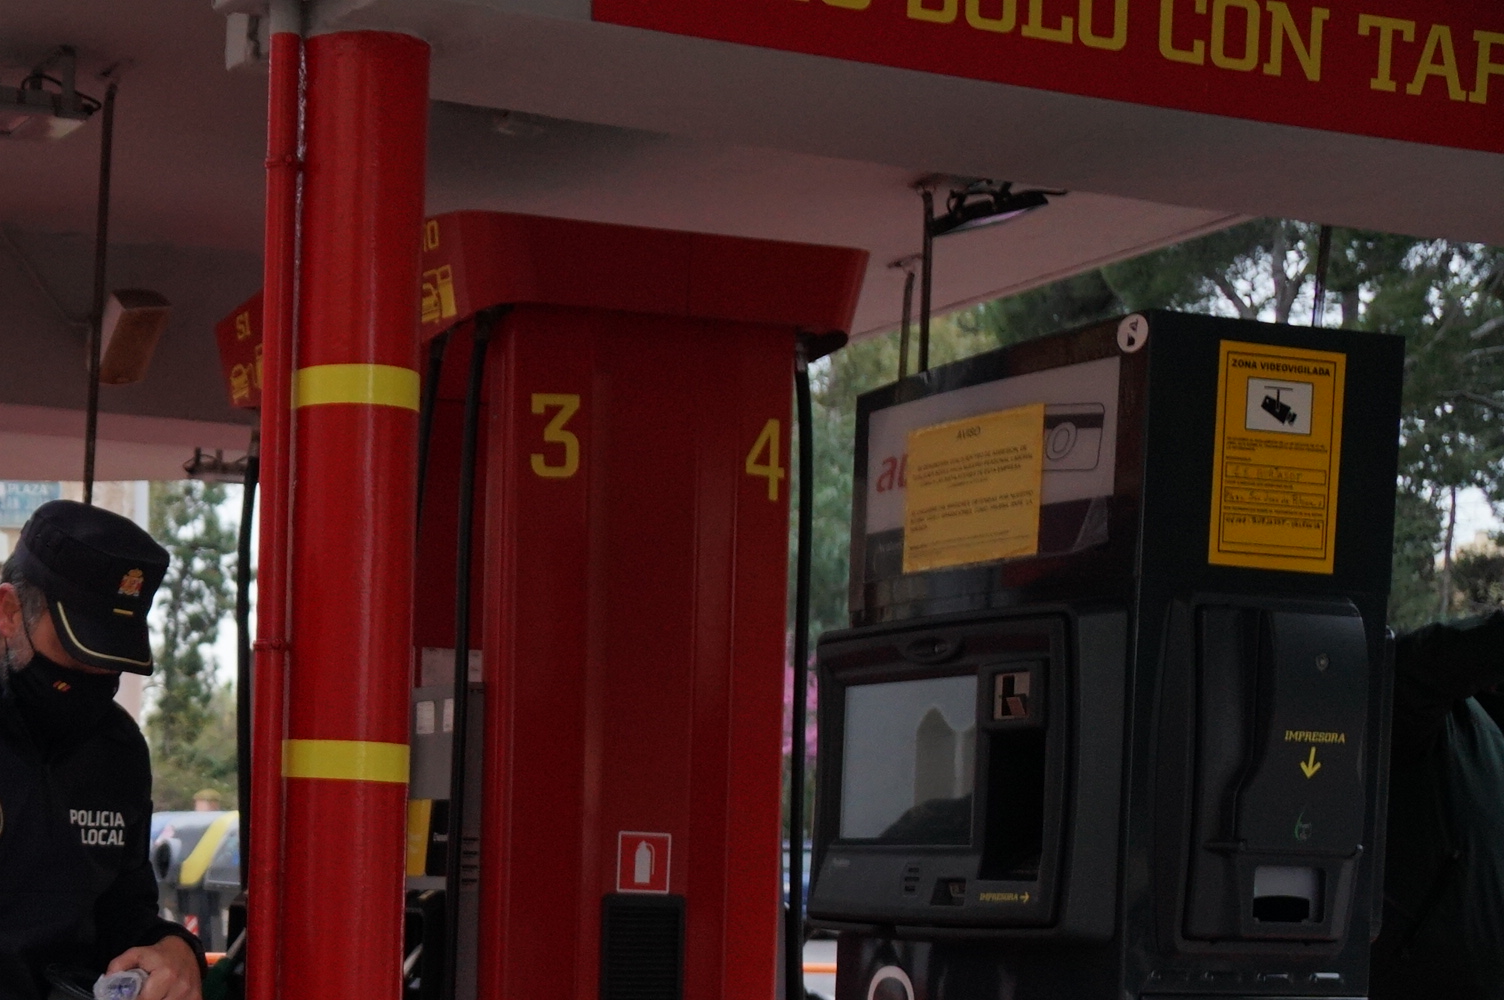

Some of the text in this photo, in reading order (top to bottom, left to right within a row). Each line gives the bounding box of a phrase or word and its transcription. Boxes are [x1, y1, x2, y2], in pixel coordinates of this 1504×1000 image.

[1158, 0, 1330, 82] CON
[1232, 359, 1330, 377] ZONA VIDEOVIGILADA
[530, 393, 784, 501] 3 4
[1284, 730, 1346, 744] IMPRESORA
[69, 809, 125, 827] POLICIA
[81, 828, 125, 845] LOCAL
[979, 892, 1018, 901] IMPRESORA
